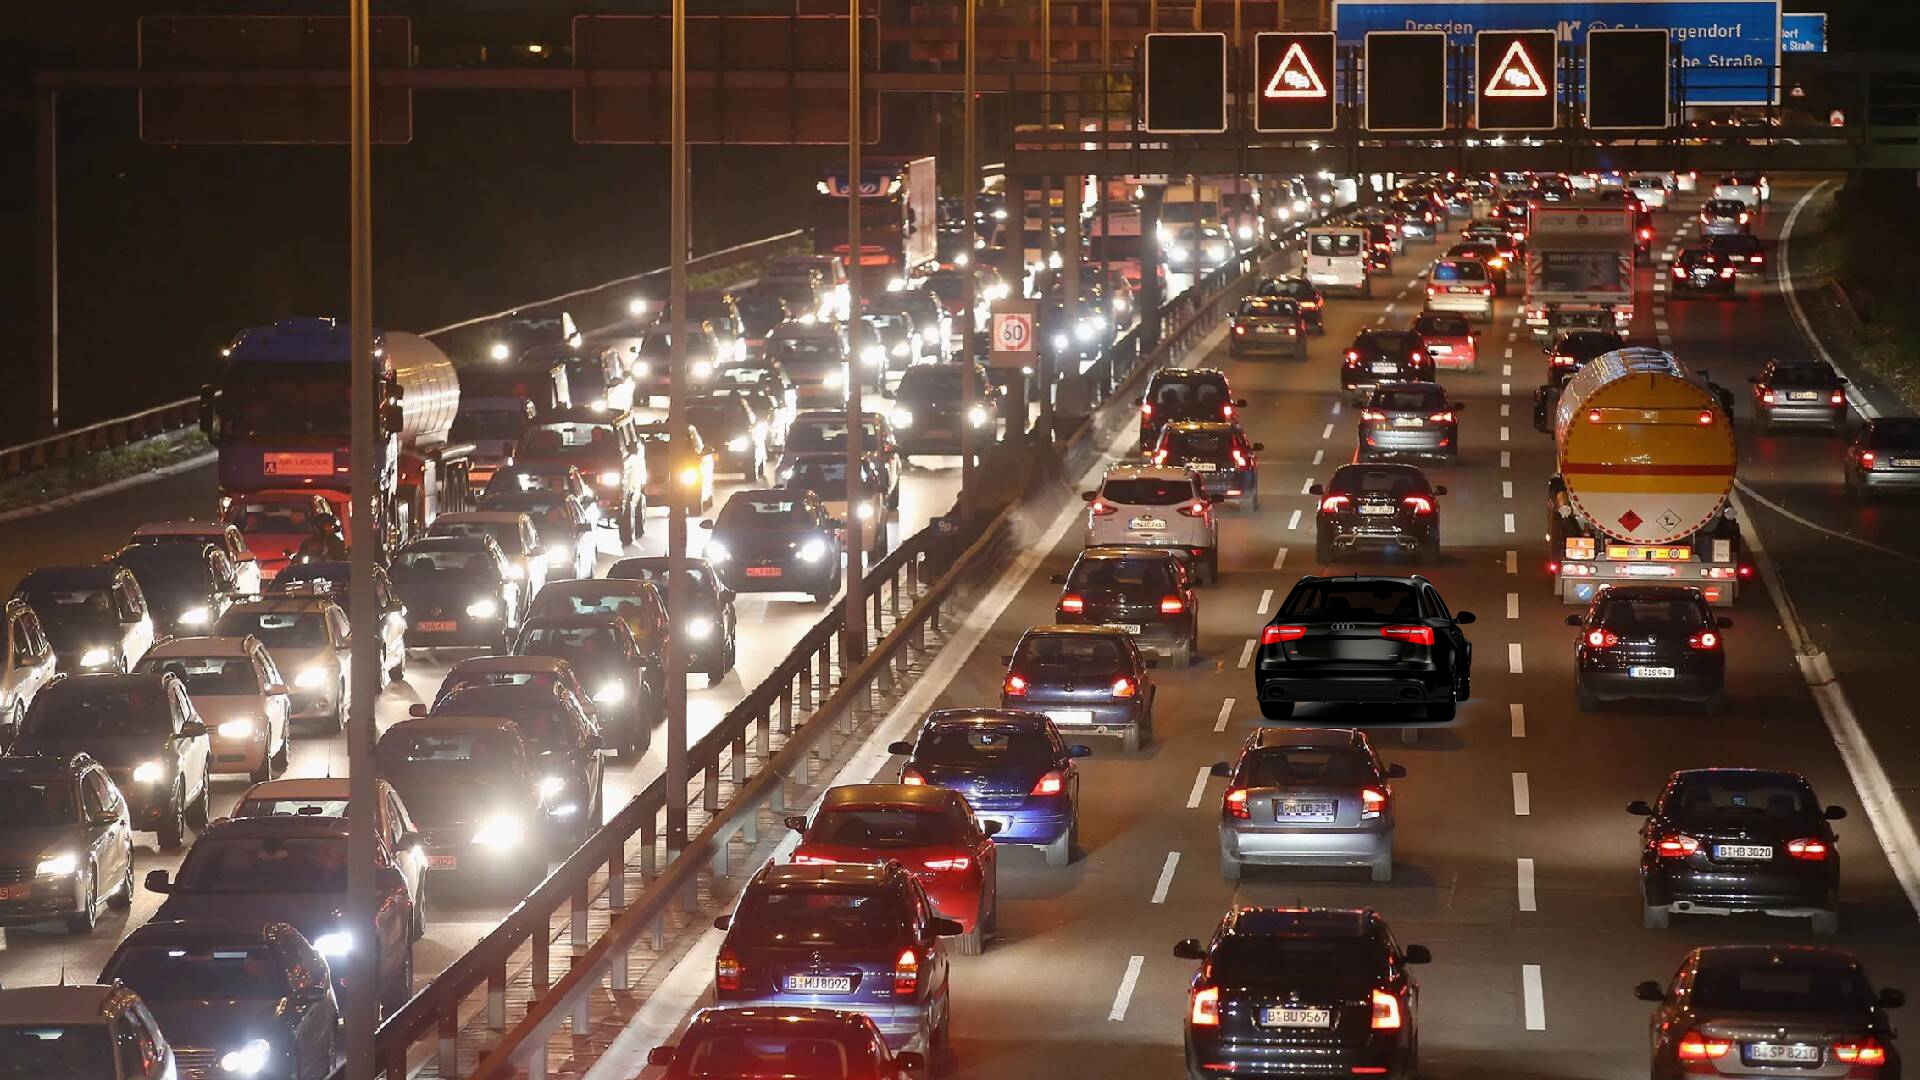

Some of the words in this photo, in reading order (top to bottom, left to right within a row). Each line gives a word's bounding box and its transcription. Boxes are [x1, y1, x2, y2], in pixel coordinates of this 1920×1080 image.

[1405, 19, 1473, 35] Dresden
[1708, 54, 1764, 68] Straße
[1002, 323, 1023, 341] 60
[1720, 846, 1727, 856] B
[1747, 847, 1771, 857] 3020
[789, 977, 797, 989] B
[820, 978, 849, 990] 8092
[1267, 1011, 1276, 1022] B
[1283, 1011, 1298, 1023] BU
[1300, 1011, 1329, 1023] 9567
[1753, 1047, 1761, 1057] B
[1769, 1047, 1785, 1059] SP
[1787, 1048, 1817, 1060] 8210
